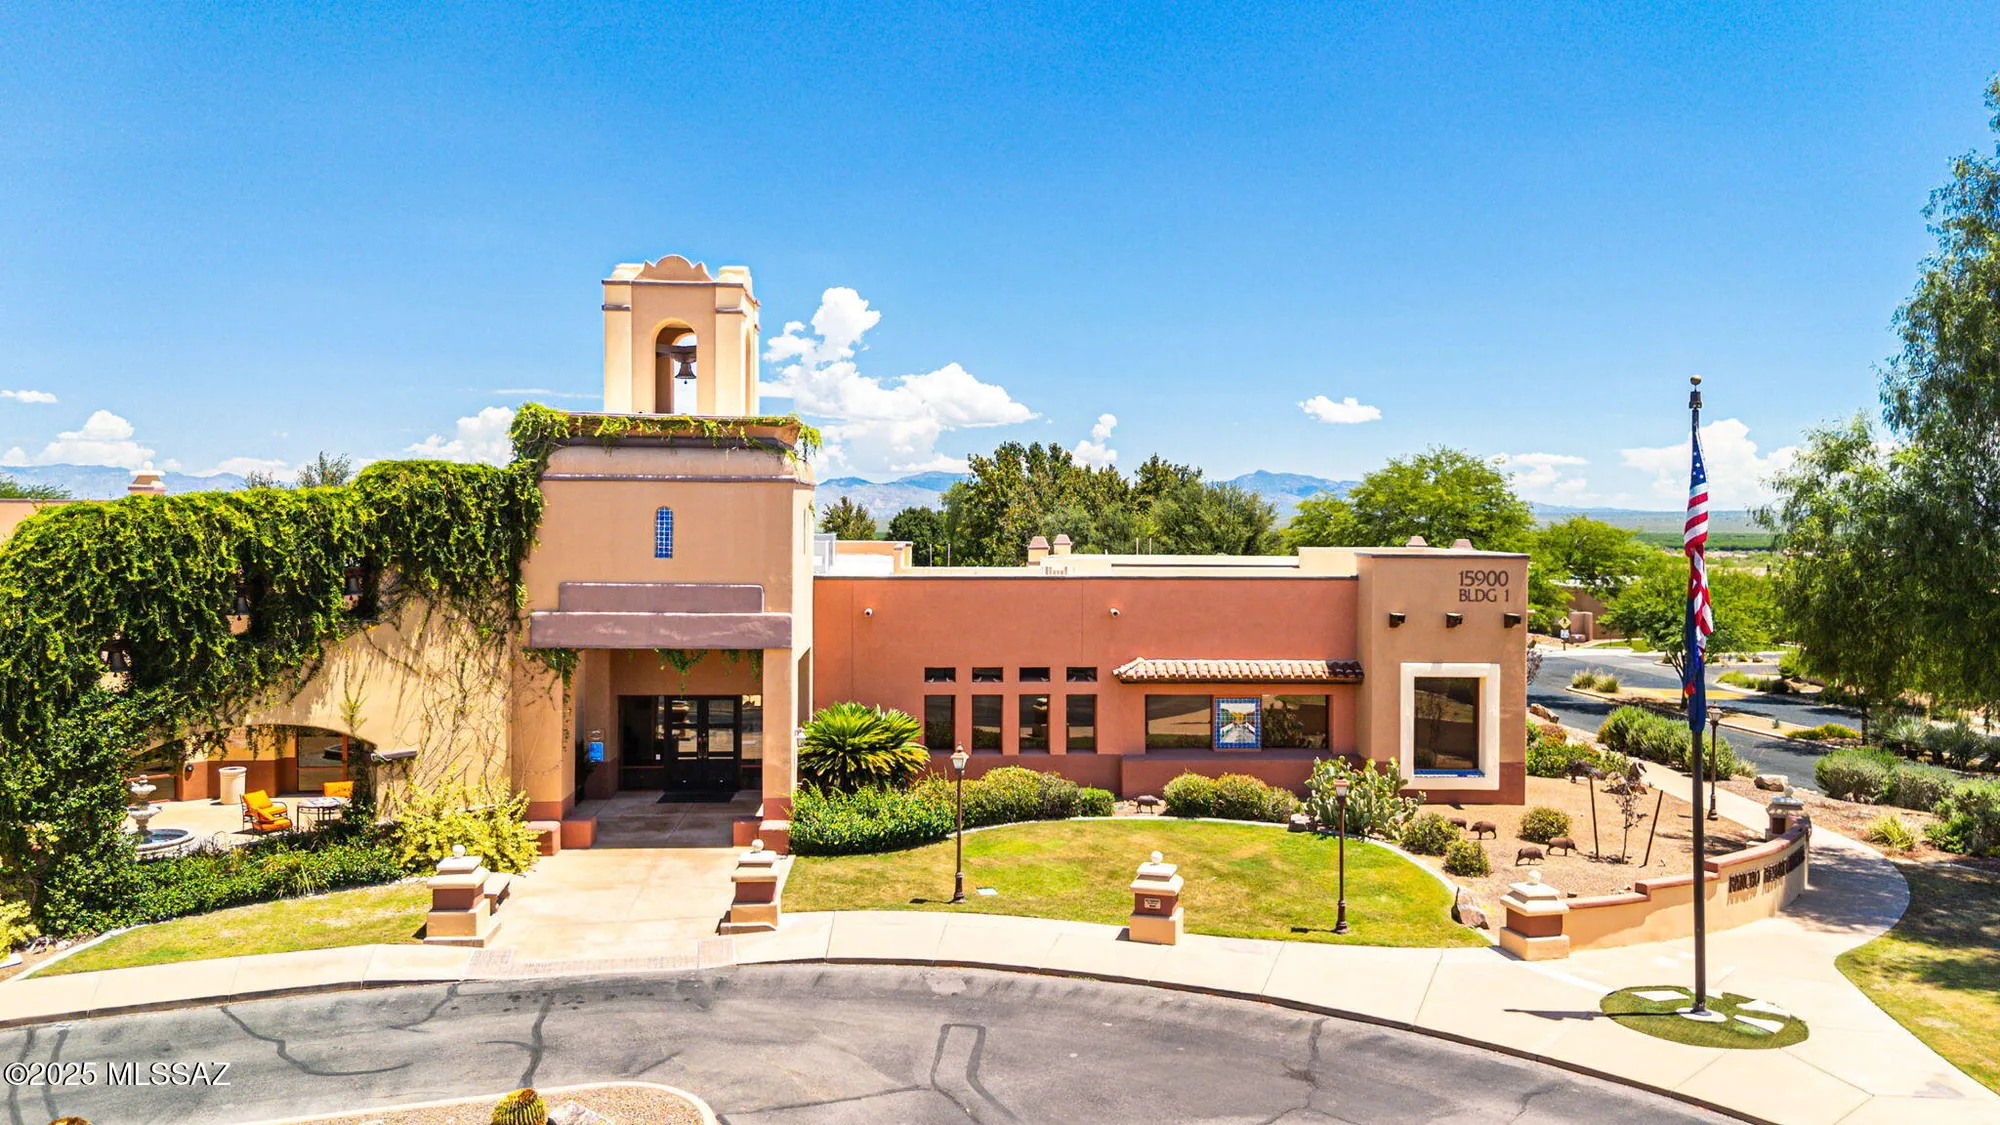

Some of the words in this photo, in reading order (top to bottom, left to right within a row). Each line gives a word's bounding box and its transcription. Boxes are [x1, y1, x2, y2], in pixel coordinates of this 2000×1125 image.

[1459, 570, 1509, 587] 15900
[1459, 588, 1497, 602] BLDG
[1504, 588, 1509, 602] 1
